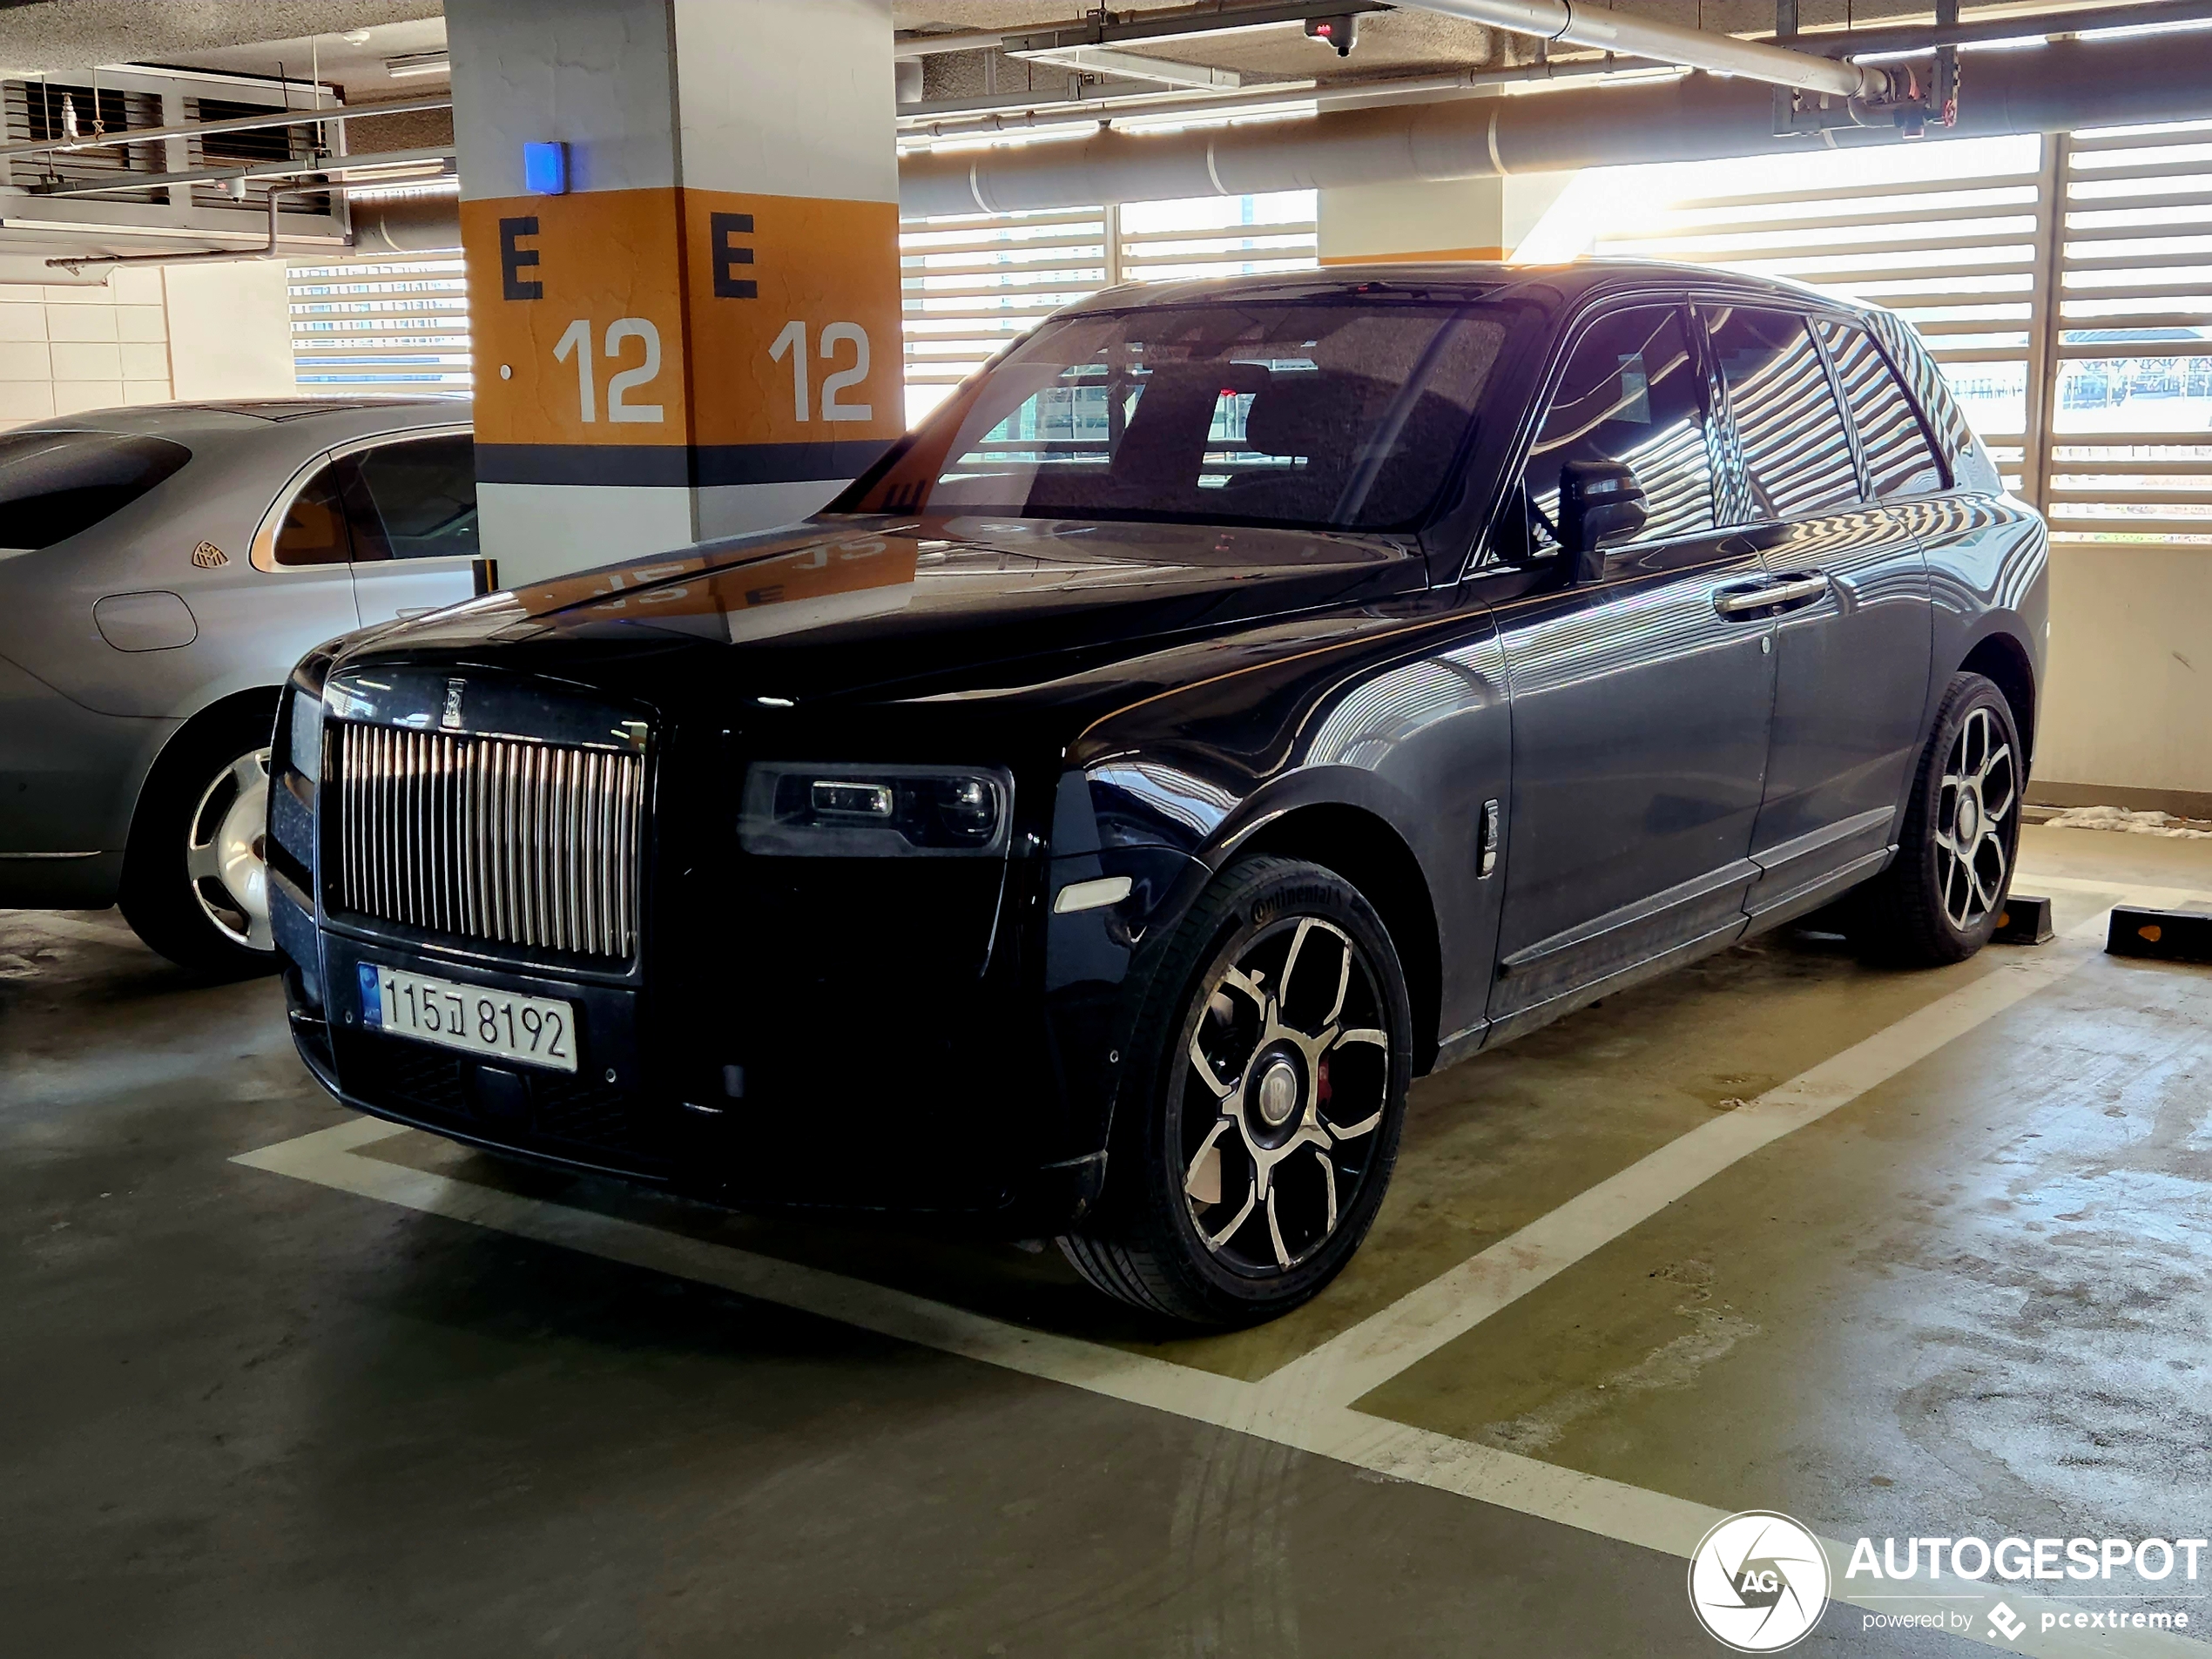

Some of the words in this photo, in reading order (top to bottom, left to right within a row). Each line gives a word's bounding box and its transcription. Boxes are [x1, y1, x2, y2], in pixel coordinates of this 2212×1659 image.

[500, 217, 543, 300] E
[710, 212, 758, 298] E
[553, 318, 664, 424] 12
[768, 320, 873, 422] 12
